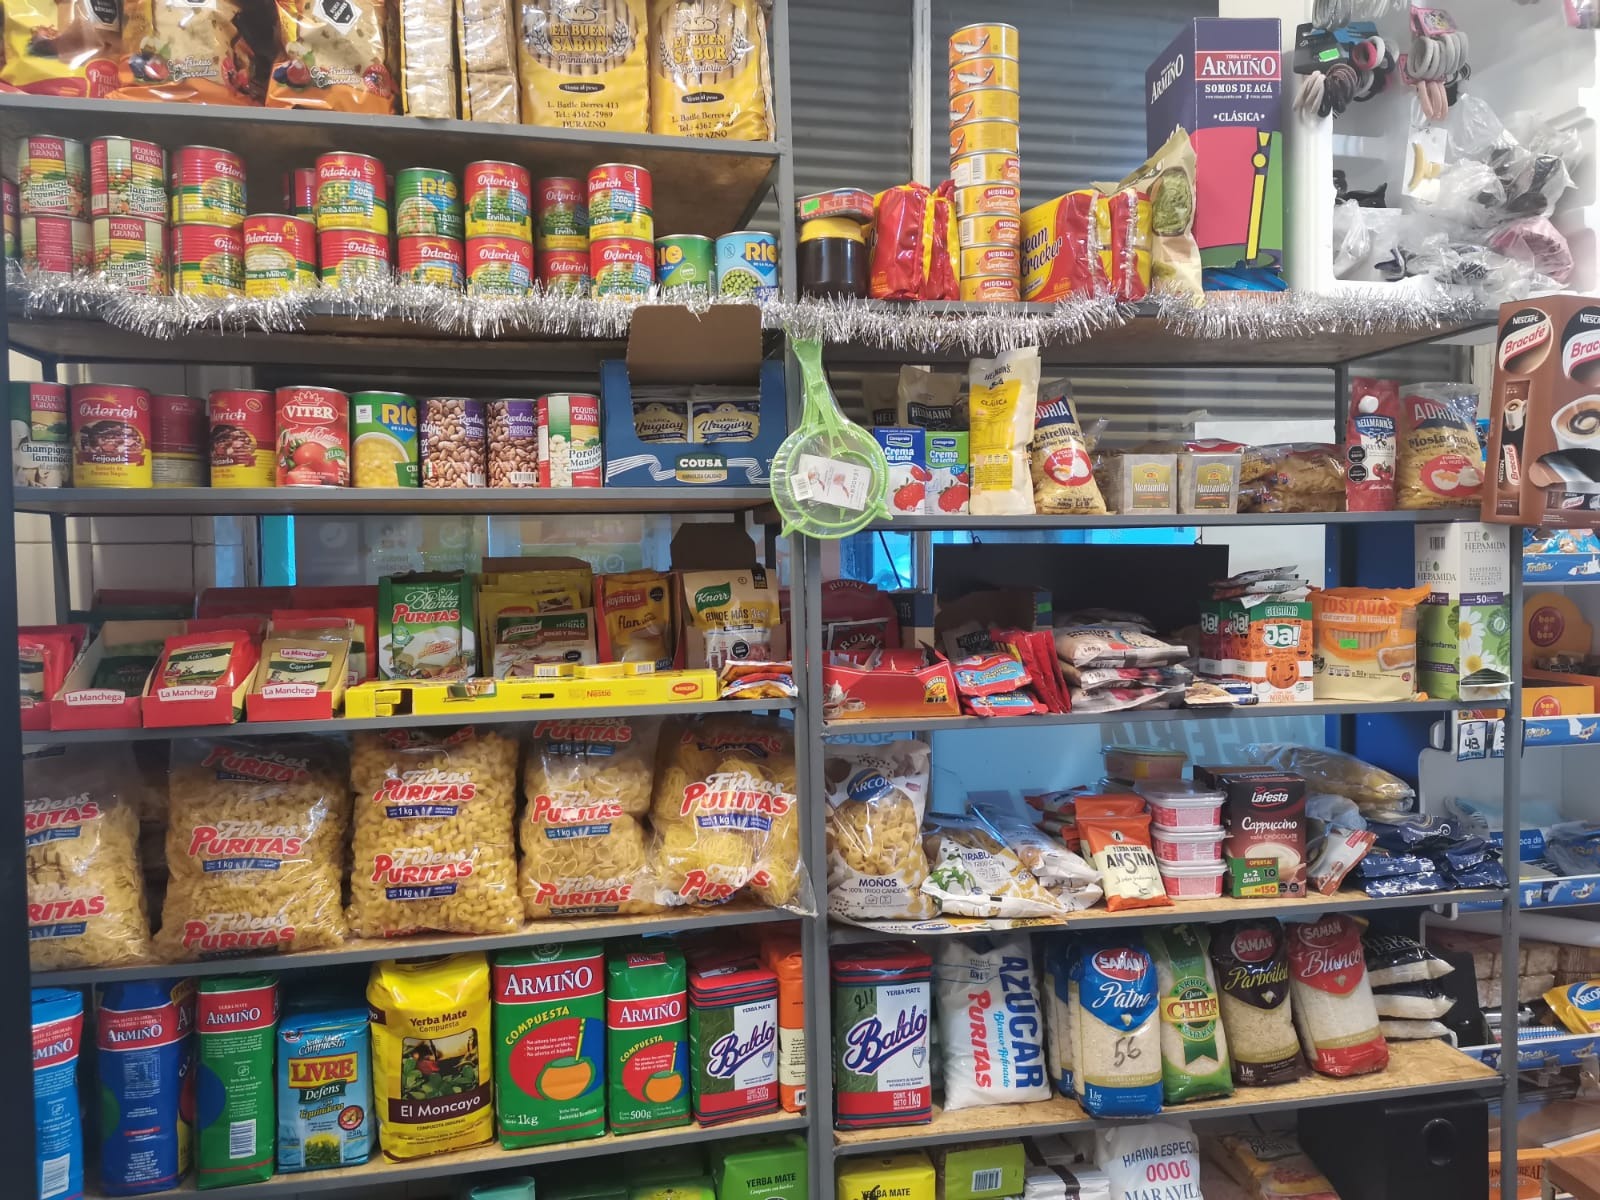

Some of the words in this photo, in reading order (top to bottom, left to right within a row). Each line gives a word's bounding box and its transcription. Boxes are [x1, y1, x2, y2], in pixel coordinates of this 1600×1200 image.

[551, 24, 568, 37] EL
[570, 23, 606, 37] BUEN
[551, 37, 609, 54] SABOR
[691, 34, 727, 47] BUEN
[673, 46, 727, 64] SABOR
[1201, 55, 1277, 76] ARMIÑO
[1204, 84, 1238, 93] SOMOS
[1239, 84, 1252, 93] DE
[1253, 81, 1274, 94] ACÁ
[607, 102, 619, 110] 413
[1218, 109, 1261, 122] CLÁSICA
[562, 120, 607, 129] DURAZNO
[1511, 312, 1540, 325] NESCAFÉ
[1503, 322, 1547, 353] Bracafé
[79, 404, 138, 420] Oderich
[285, 405, 335, 421] VITER
[697, 419, 754, 434] Uruguay
[884, 446, 916, 458] Crema
[929, 449, 959, 459] Crema
[679, 458, 724, 469] COUSA
[1463, 528, 1481, 543] TÉ
[1464, 540, 1507, 551] HEPAMIDA
[1416, 571, 1458, 583] HEPAMIDA
[695, 590, 731, 604] Knorr
[1476, 594, 1488, 604] 50
[391, 603, 461, 624] PURITAS
[705, 610, 729, 622] RINDE
[1321, 599, 1400, 616] TOSTADAS
[617, 614, 642, 630] flan
[1233, 612, 1251, 634] Ja!
[1262, 623, 1302, 648] Ja!
[67, 694, 79, 702] La
[79, 693, 122, 704] Manchega
[160, 690, 172, 699] La
[172, 688, 214, 699] Manchega
[263, 687, 275, 696] La
[275, 685, 316, 697] Manchega
[372, 777, 477, 803] PURITAS
[702, 771, 785, 797] Fideos
[849, 776, 894, 796] ARCOR
[679, 781, 790, 818] PURITAS
[1250, 791, 1289, 804] LaFesta
[530, 793, 624, 825] PURITAS
[216, 819, 298, 838] Fideos
[1240, 816, 1299, 835] Cappuccino
[187, 823, 302, 857] PURITAS
[391, 846, 467, 867] Fideos
[1106, 852, 1156, 874] ANSINA
[370, 853, 474, 884] PURITAS
[1263, 867, 1277, 878] 10
[857, 876, 897, 888] MOÑOS
[533, 881, 634, 907] PURITAS
[182, 918, 298, 952] PURITAS
[1303, 920, 1342, 941] SAMAN
[1235, 935, 1274, 954] SAMAN
[1098, 952, 1146, 972] SAMAN
[1300, 946, 1365, 979] Blanco
[503, 966, 594, 996] ARMIÑO
[1223, 963, 1290, 992] Parboiled
[886, 988, 905, 997] YERBA
[905, 986, 921, 995] MATE
[206, 1007, 262, 1025] ARMIÑO
[410, 1014, 441, 1028] Yerba
[442, 1009, 469, 1023] Mate
[619, 1000, 682, 1024] ARMIÑO
[108, 1023, 164, 1044] ARMIÑO
[418, 1021, 461, 1034] Compuesta
[505, 1005, 571, 1046] COMPUESTA
[621, 1034, 664, 1062] COMPUESTA
[843, 1004, 928, 1074] Baldo
[967, 989, 993, 1089] PURITAS
[708, 1019, 777, 1079] Baldo
[1113, 1035, 1143, 1068] 56
[290, 1057, 355, 1084] LIVRE
[304, 1082, 342, 1102] Defens
[908, 1091, 922, 1108] 1kg
[400, 1104, 414, 1118] El
[417, 1094, 482, 1118] Moncayo
[517, 1113, 540, 1127] 1kg
[630, 1109, 652, 1123] 500g
[1123, 1146, 1159, 1168] HARINA
[1145, 1159, 1192, 1184] 0000
[746, 1176, 774, 1190] YERBA
[774, 1173, 797, 1187] MATE
[887, 1186, 911, 1198] MATE
